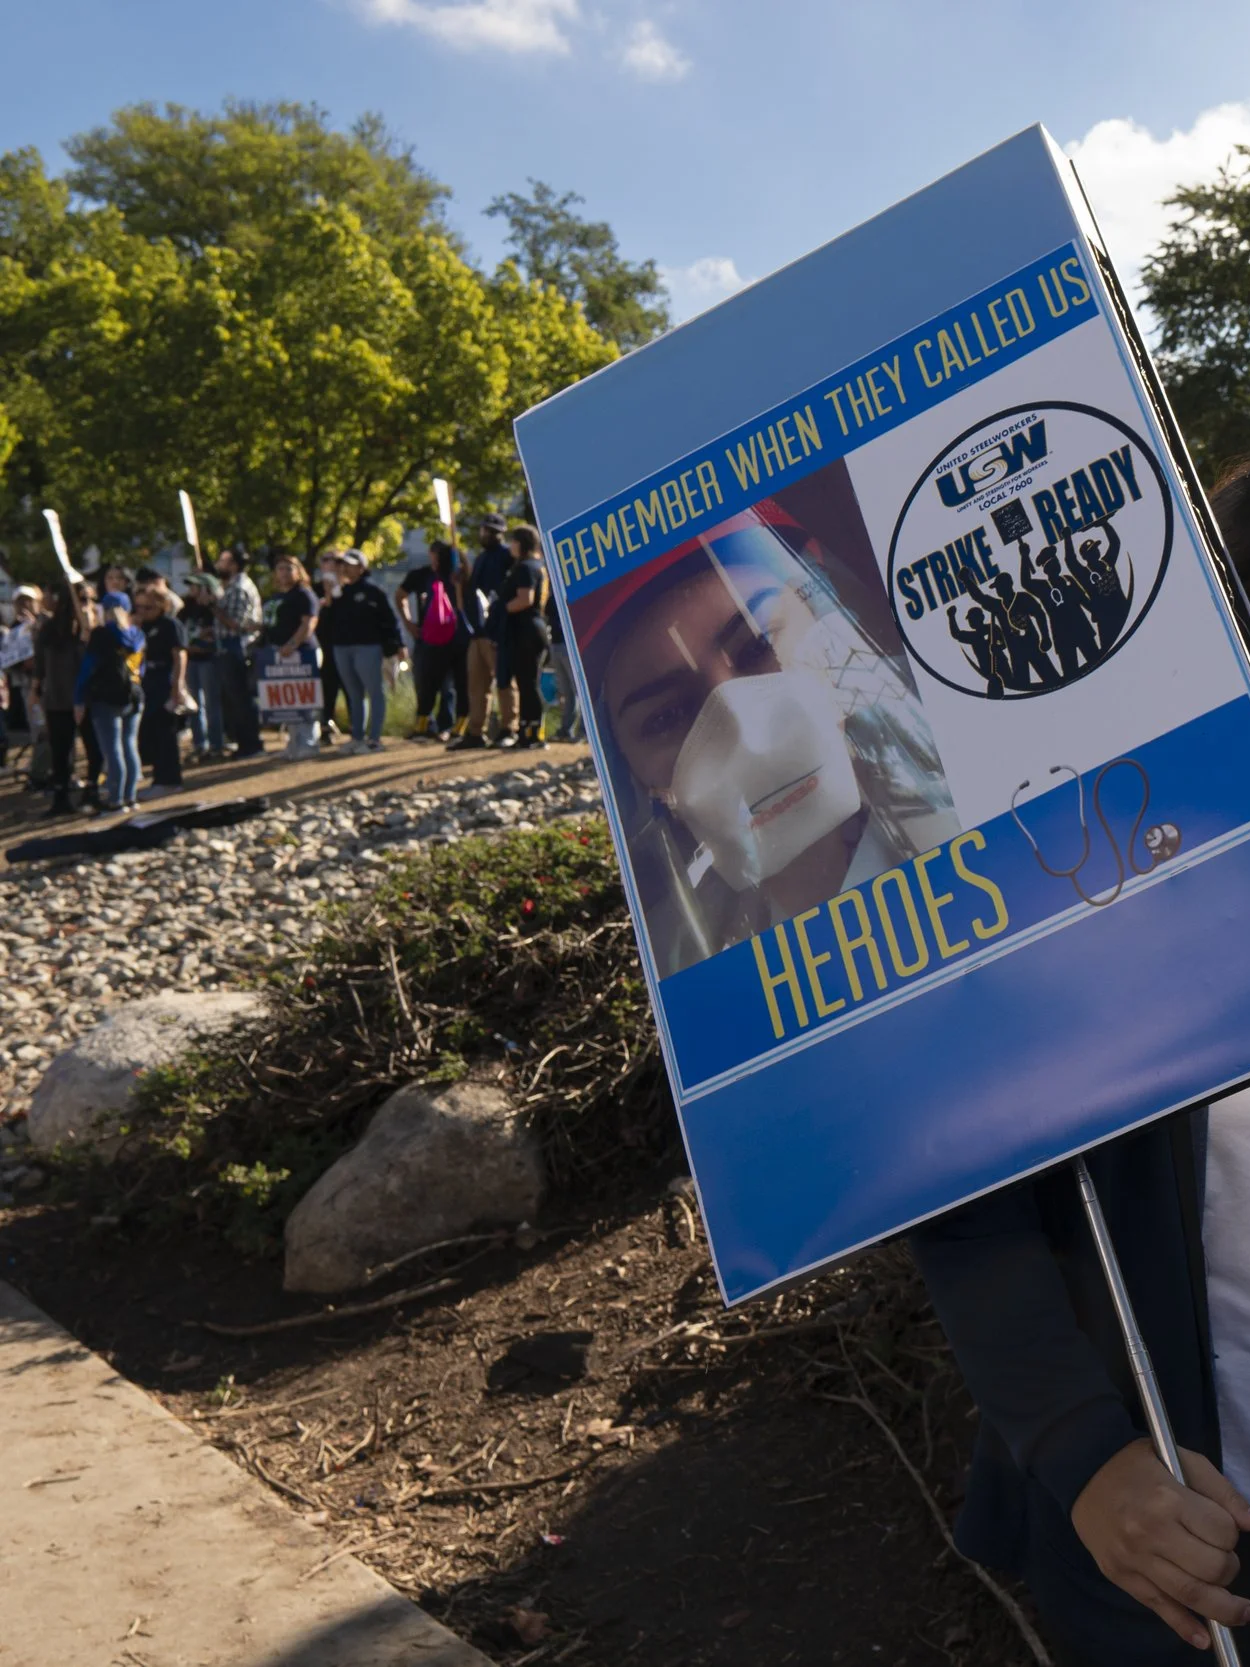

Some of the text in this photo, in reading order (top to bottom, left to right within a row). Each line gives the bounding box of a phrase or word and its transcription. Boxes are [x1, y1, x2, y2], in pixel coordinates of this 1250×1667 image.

[558, 257, 1091, 586] REMEMBER WHEN THEY CALLED US
[936, 413, 1038, 474] UNITED STEELWORKERS
[935, 418, 1048, 508] USW
[956, 460, 1048, 513] UNITY AND STRENGTH FOR WORKERS
[978, 476, 1033, 511] LOCAL 7600
[896, 443, 1143, 621] STRIKE READY
[266, 680, 317, 709] NOW
[751, 830, 1009, 1039] HEROES
